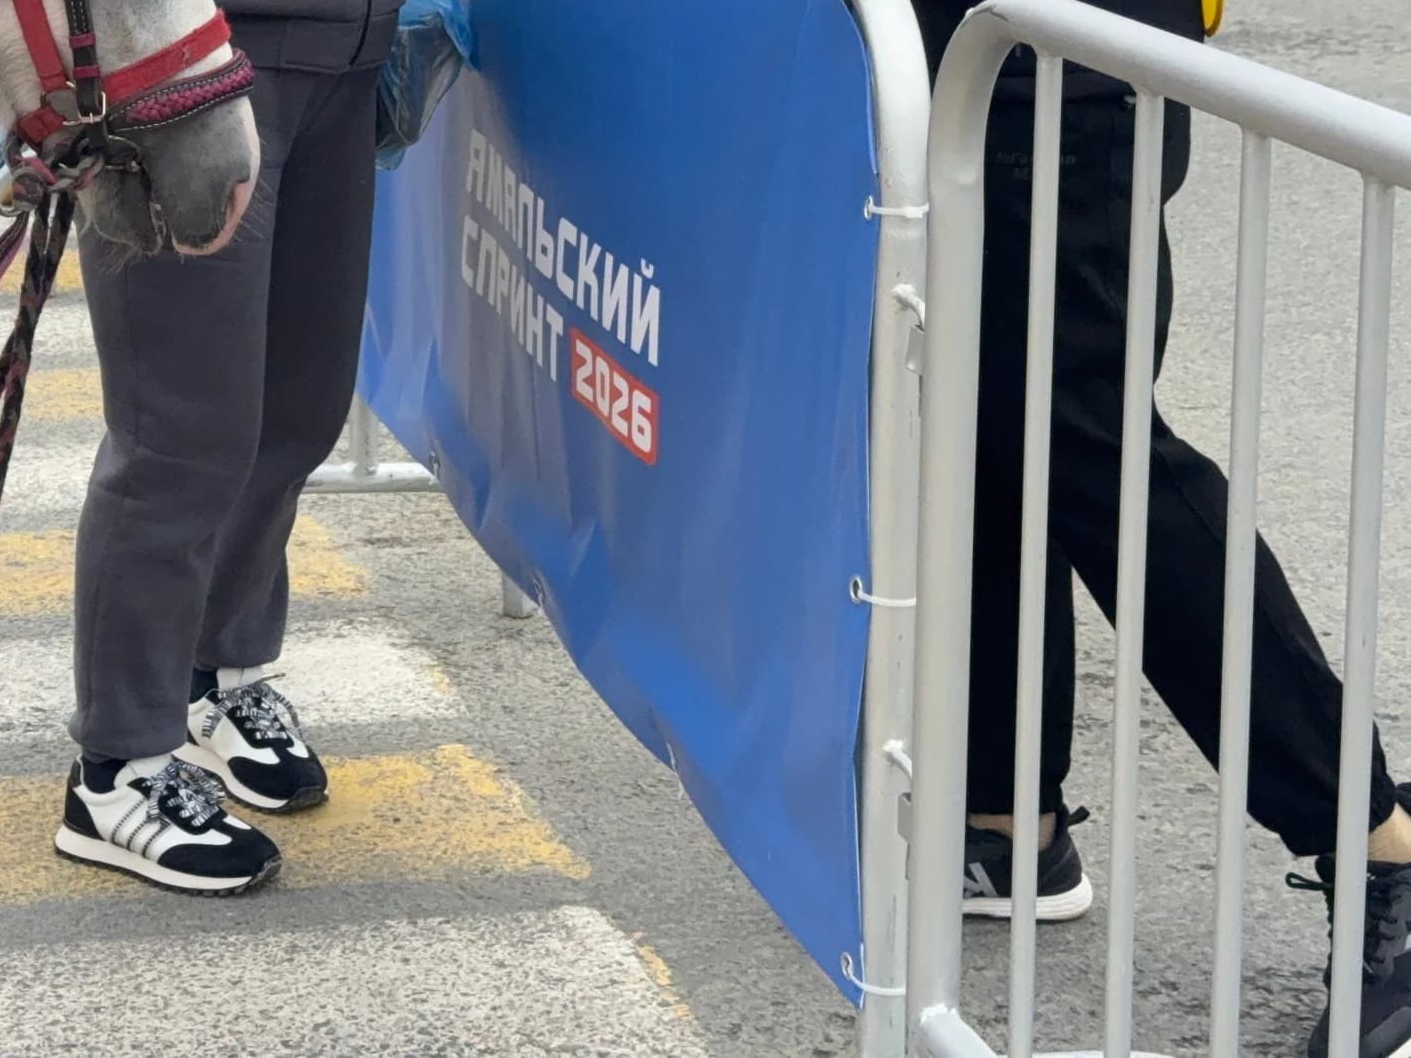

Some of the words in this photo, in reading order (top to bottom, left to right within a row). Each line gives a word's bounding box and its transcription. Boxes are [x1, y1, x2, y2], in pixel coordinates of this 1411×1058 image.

[461, 214, 564, 383] СПРИНТ
[574, 338, 652, 454] 2026
[466, 127, 661, 368] ЯМАЛЬСКИЙ
